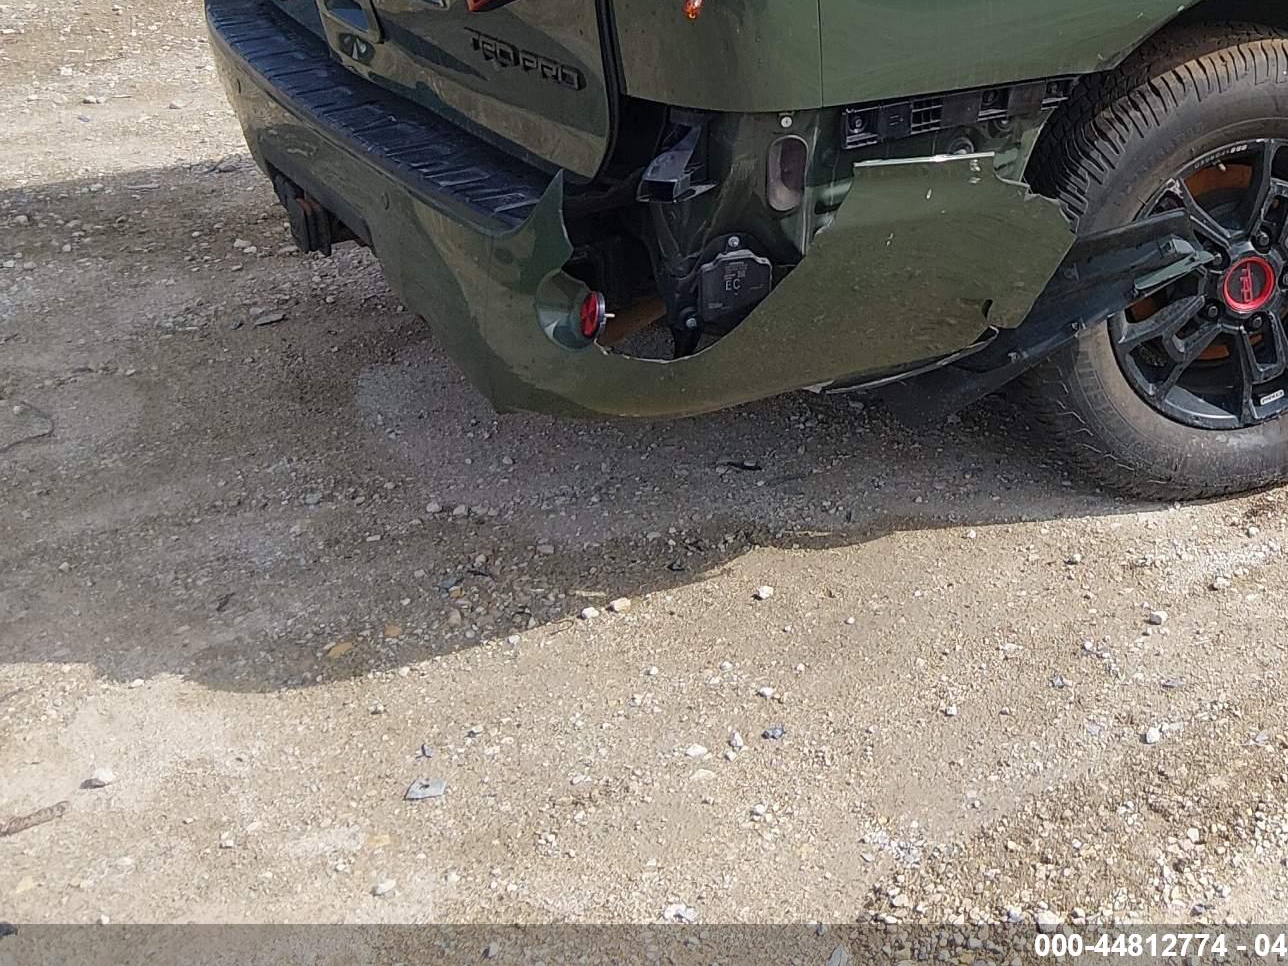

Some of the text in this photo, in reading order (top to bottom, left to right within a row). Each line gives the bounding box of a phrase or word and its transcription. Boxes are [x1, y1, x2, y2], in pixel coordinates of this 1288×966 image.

[463, 25, 587, 91] TRD PRO
[725, 278, 741, 291] EC
